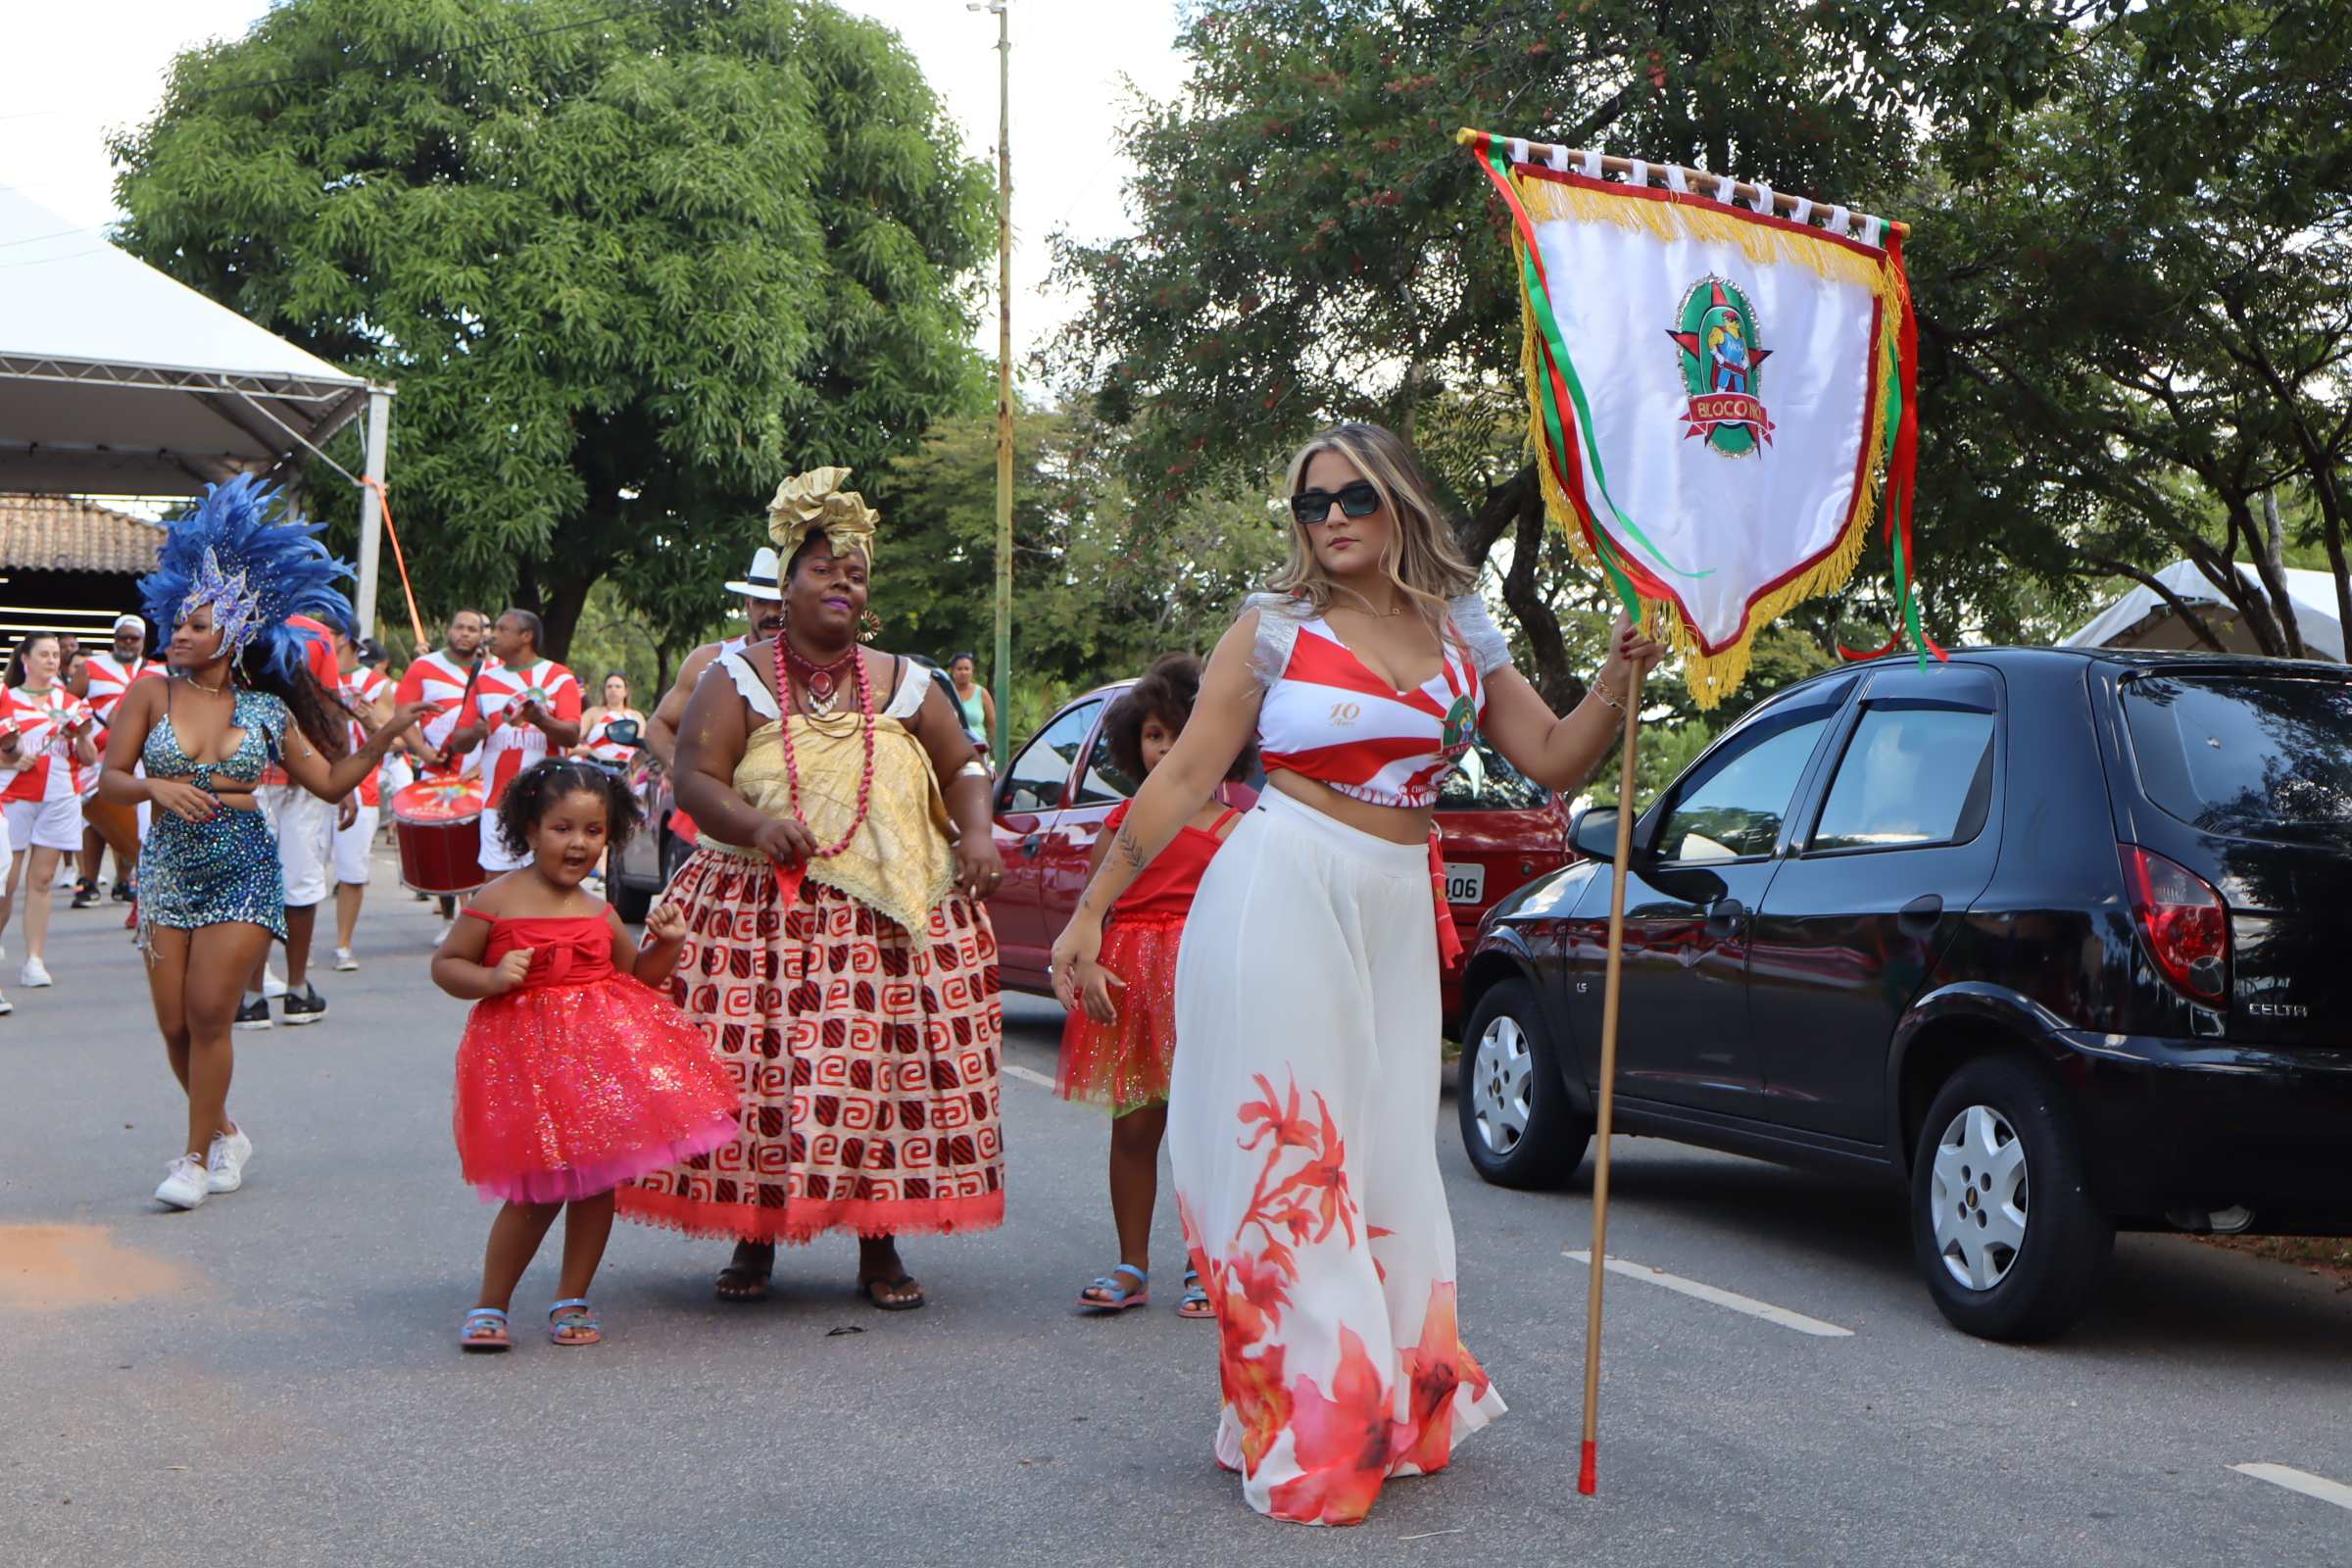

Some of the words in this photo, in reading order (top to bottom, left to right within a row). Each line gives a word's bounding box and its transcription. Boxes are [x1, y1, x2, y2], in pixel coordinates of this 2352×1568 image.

[1697, 400, 1747, 417] BLOCO
[1328, 702, 1361, 720] 10
[2249, 1004, 2307, 1016] CELTA
